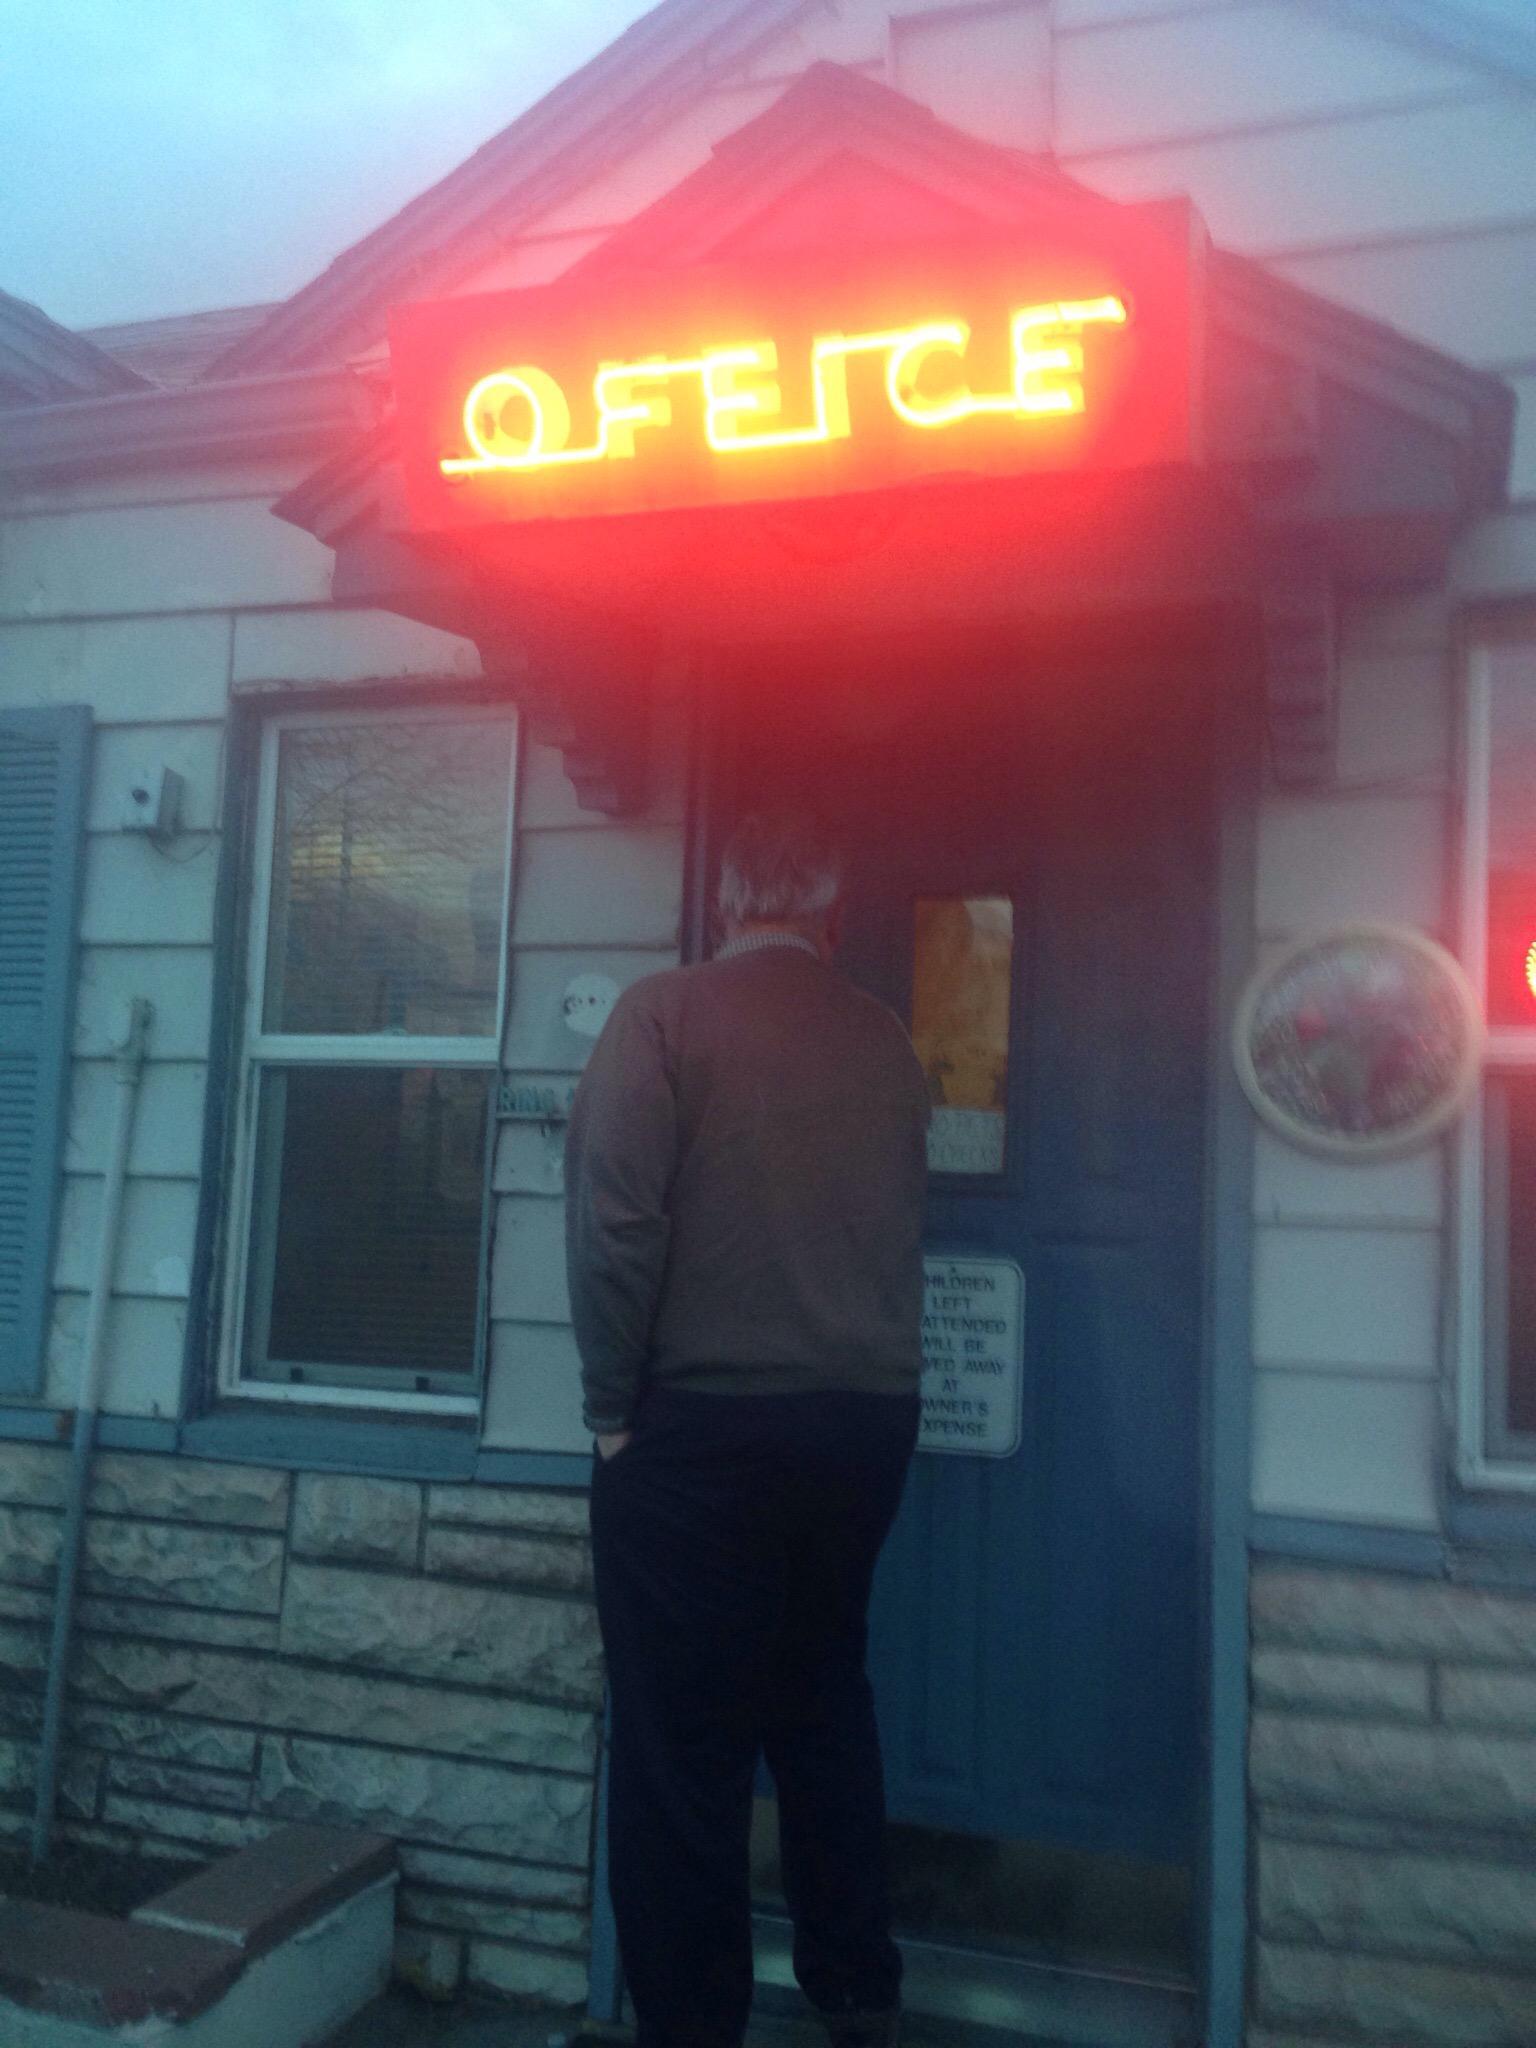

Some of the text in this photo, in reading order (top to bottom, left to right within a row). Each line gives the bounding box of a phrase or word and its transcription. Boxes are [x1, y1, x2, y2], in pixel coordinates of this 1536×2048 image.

[923, 1274, 996, 1292] HILDREN
[932, 1296, 972, 1311] LEFT
[920, 1315, 1008, 1335] ATTENDED
[964, 1339, 987, 1354] BE
[964, 1359, 1006, 1375] AWAY
[942, 1378, 960, 1393] AT
[920, 1398, 990, 1417] WNER'S
[921, 1418, 991, 1437] XPENSE
